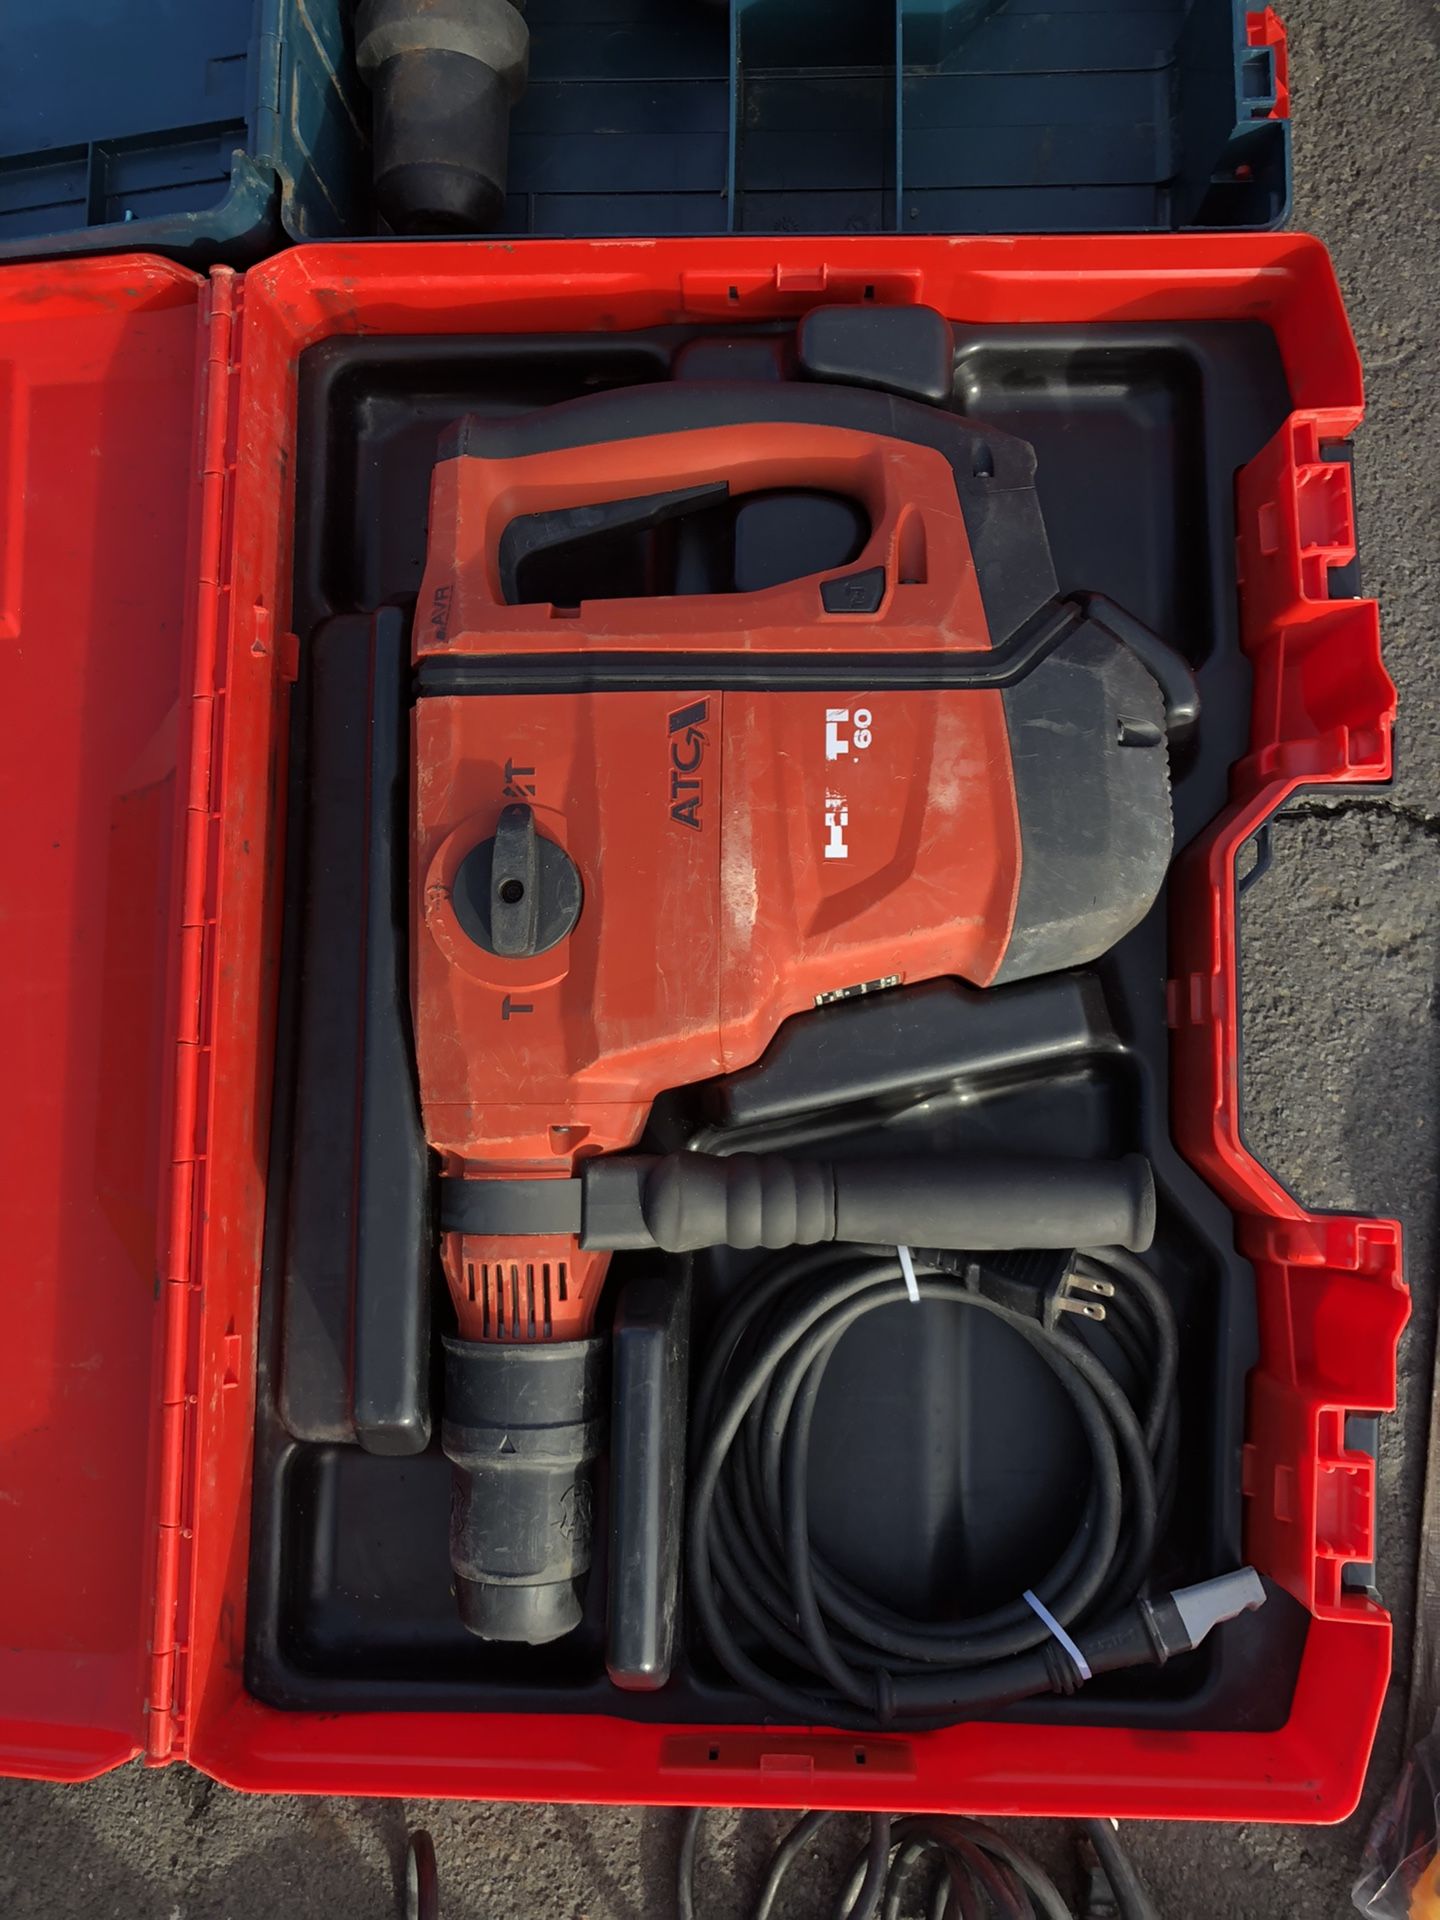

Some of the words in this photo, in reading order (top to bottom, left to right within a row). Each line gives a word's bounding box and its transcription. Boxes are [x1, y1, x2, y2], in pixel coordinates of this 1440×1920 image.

[431, 586, 450, 626] AVR
[853, 708, 872, 749] 60
[671, 728, 704, 829] ATC
[824, 708, 849, 858] HITI
